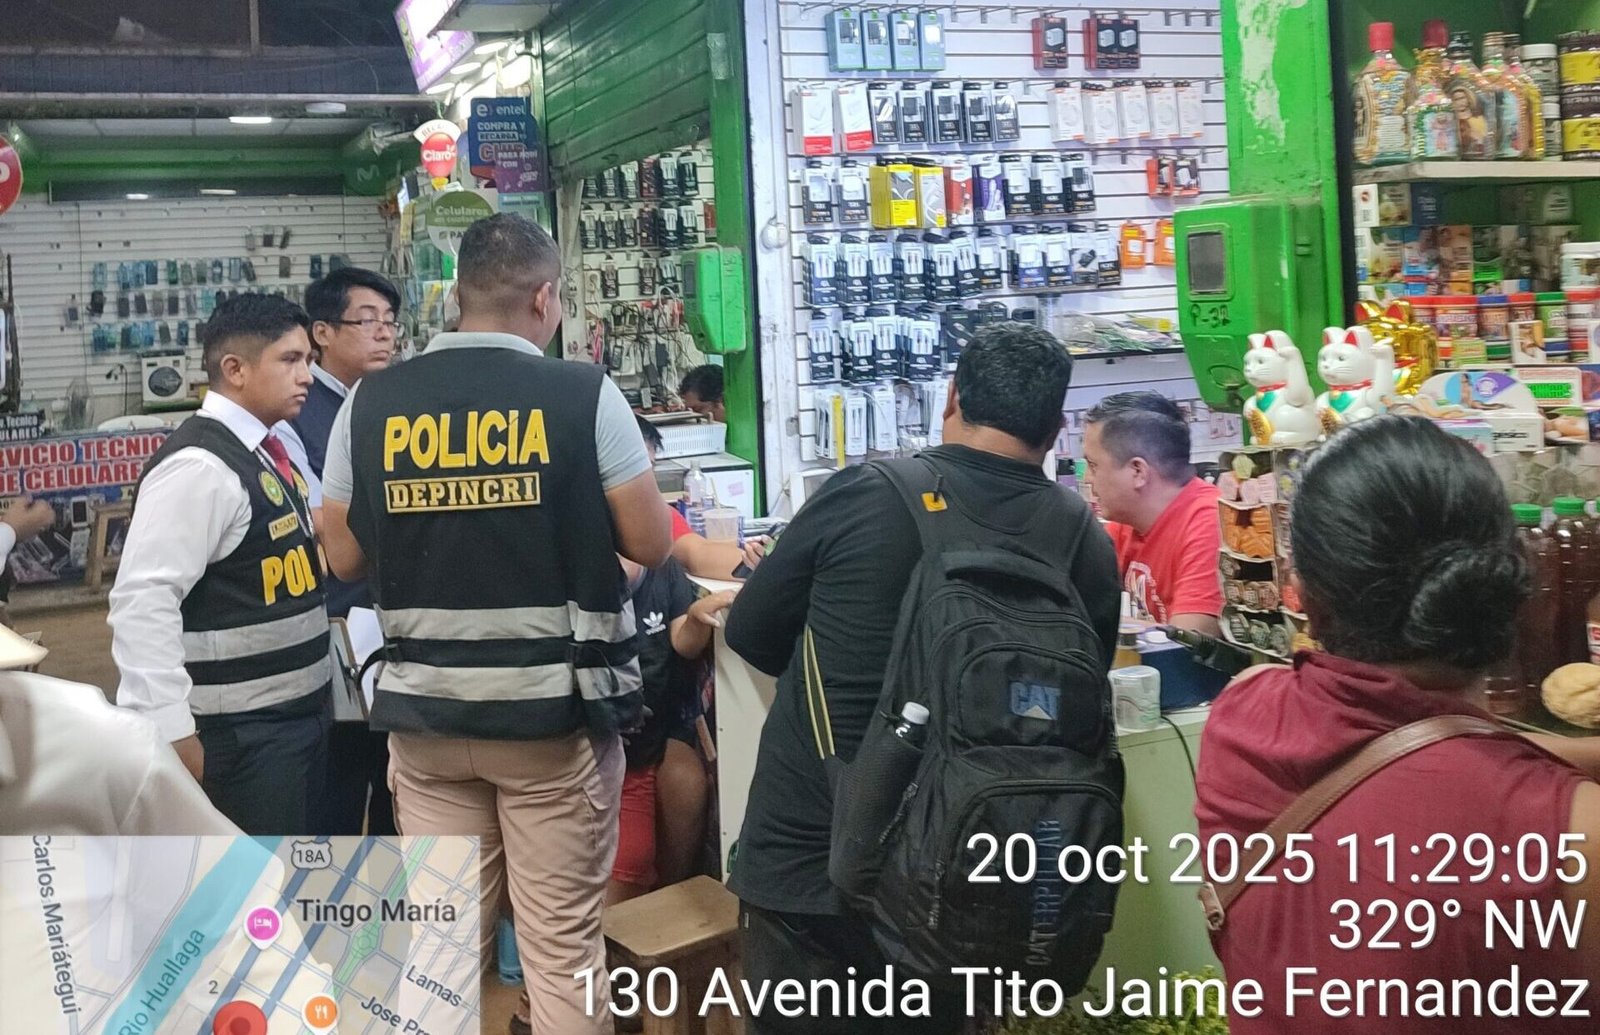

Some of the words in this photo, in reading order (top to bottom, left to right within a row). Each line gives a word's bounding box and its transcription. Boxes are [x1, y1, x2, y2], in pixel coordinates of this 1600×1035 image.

[496, 104, 526, 115] entel
[477, 121, 518, 131] COMPRA
[519, 121, 526, 130] Y
[423, 150, 452, 162] Claro
[435, 205, 489, 216] Celulares
[391, 477, 535, 508] DEPINCRI
[1010, 681, 1061, 720] CAT
